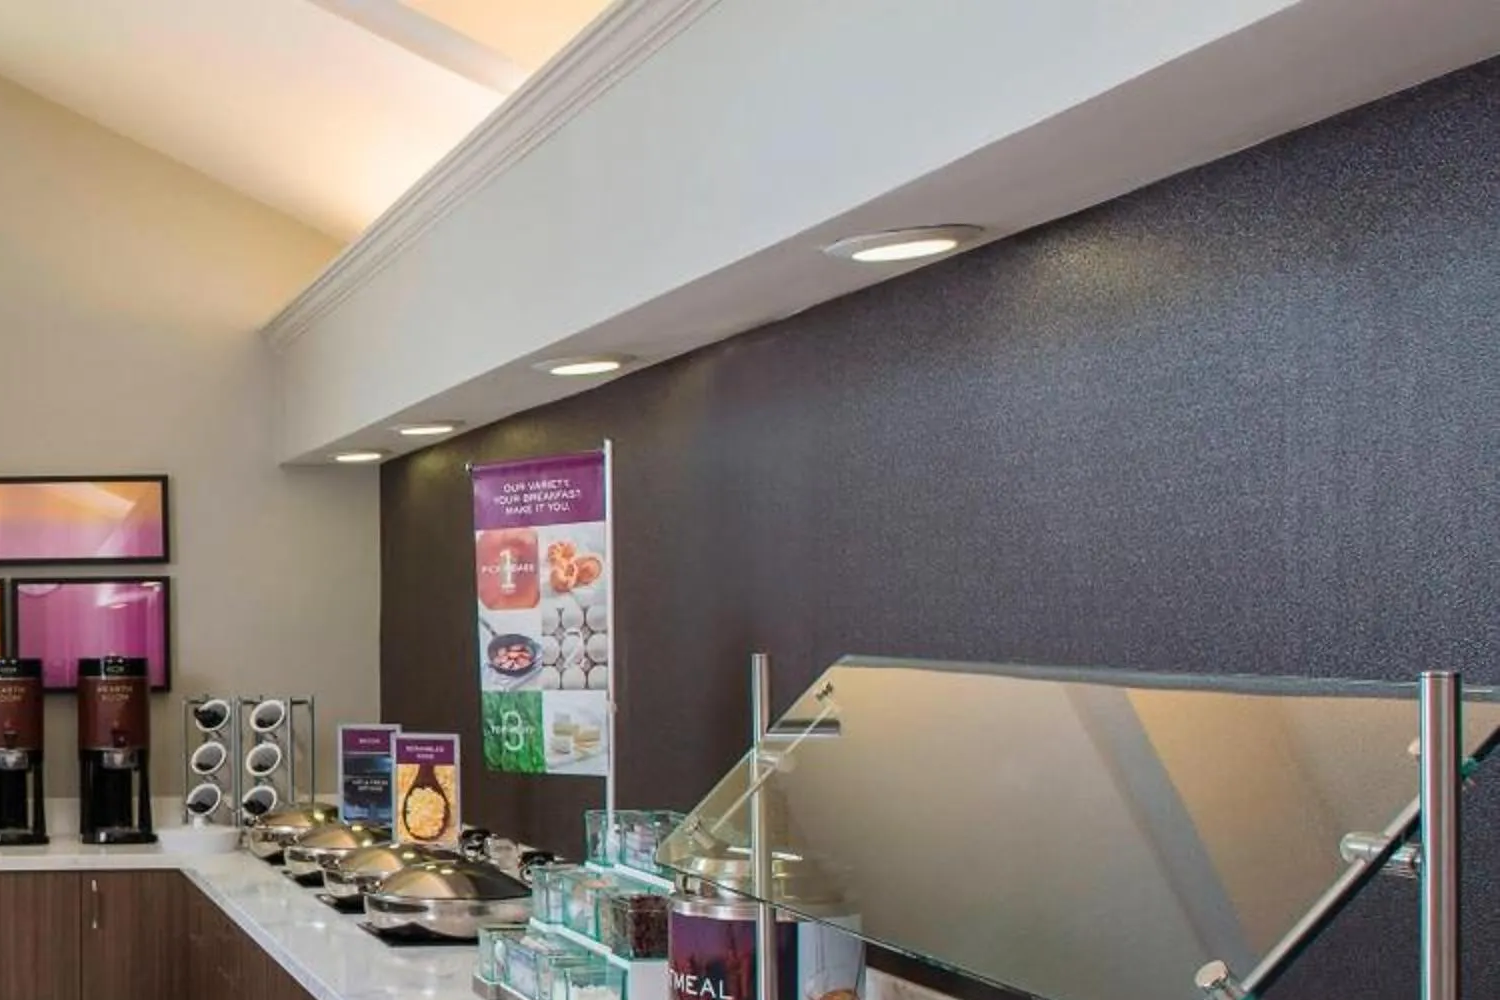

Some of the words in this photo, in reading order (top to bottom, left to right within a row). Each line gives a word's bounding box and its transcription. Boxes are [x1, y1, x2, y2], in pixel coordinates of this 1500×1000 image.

[503, 482, 525, 493] OUR
[505, 505, 532, 514] MAKE
[535, 504, 545, 512] IT
